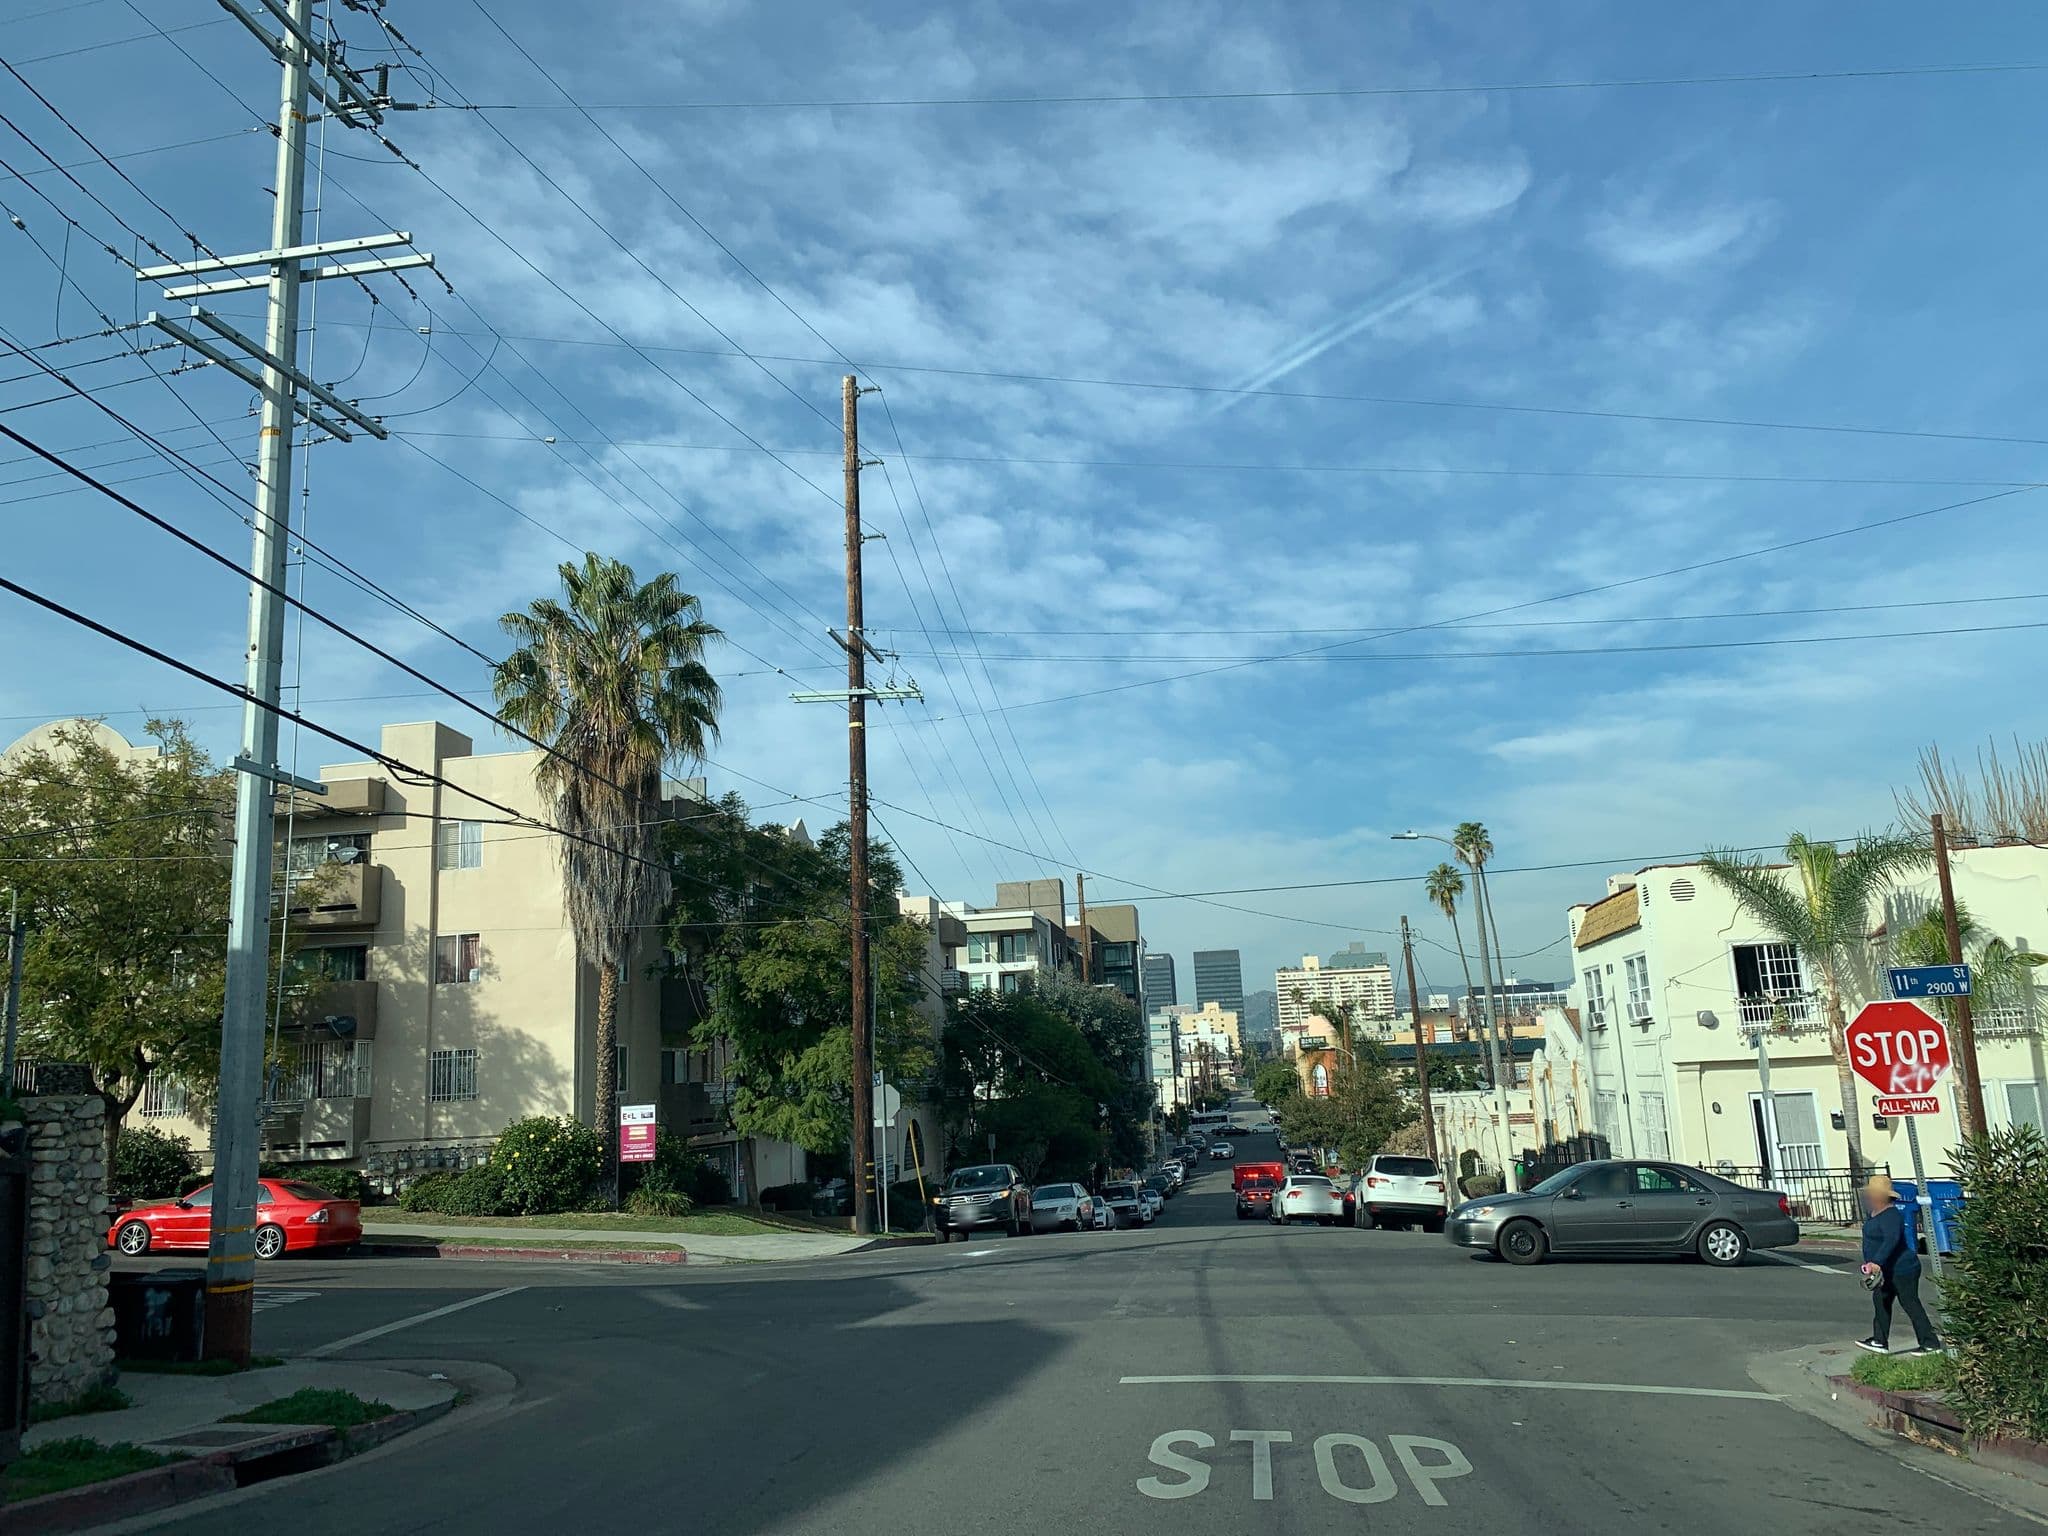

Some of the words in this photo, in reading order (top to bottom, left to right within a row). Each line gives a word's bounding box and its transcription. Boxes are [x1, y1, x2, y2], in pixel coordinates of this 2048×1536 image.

[1895, 974, 1919, 991] 11th
[1953, 967, 1966, 979] St
[1926, 982, 1955, 994] 2900
[1959, 981, 1968, 992] W
[1855, 1030, 1940, 1067] STOP
[1881, 1099, 1937, 1113] ALL-WAY
[1136, 1429, 1474, 1506] STOP
